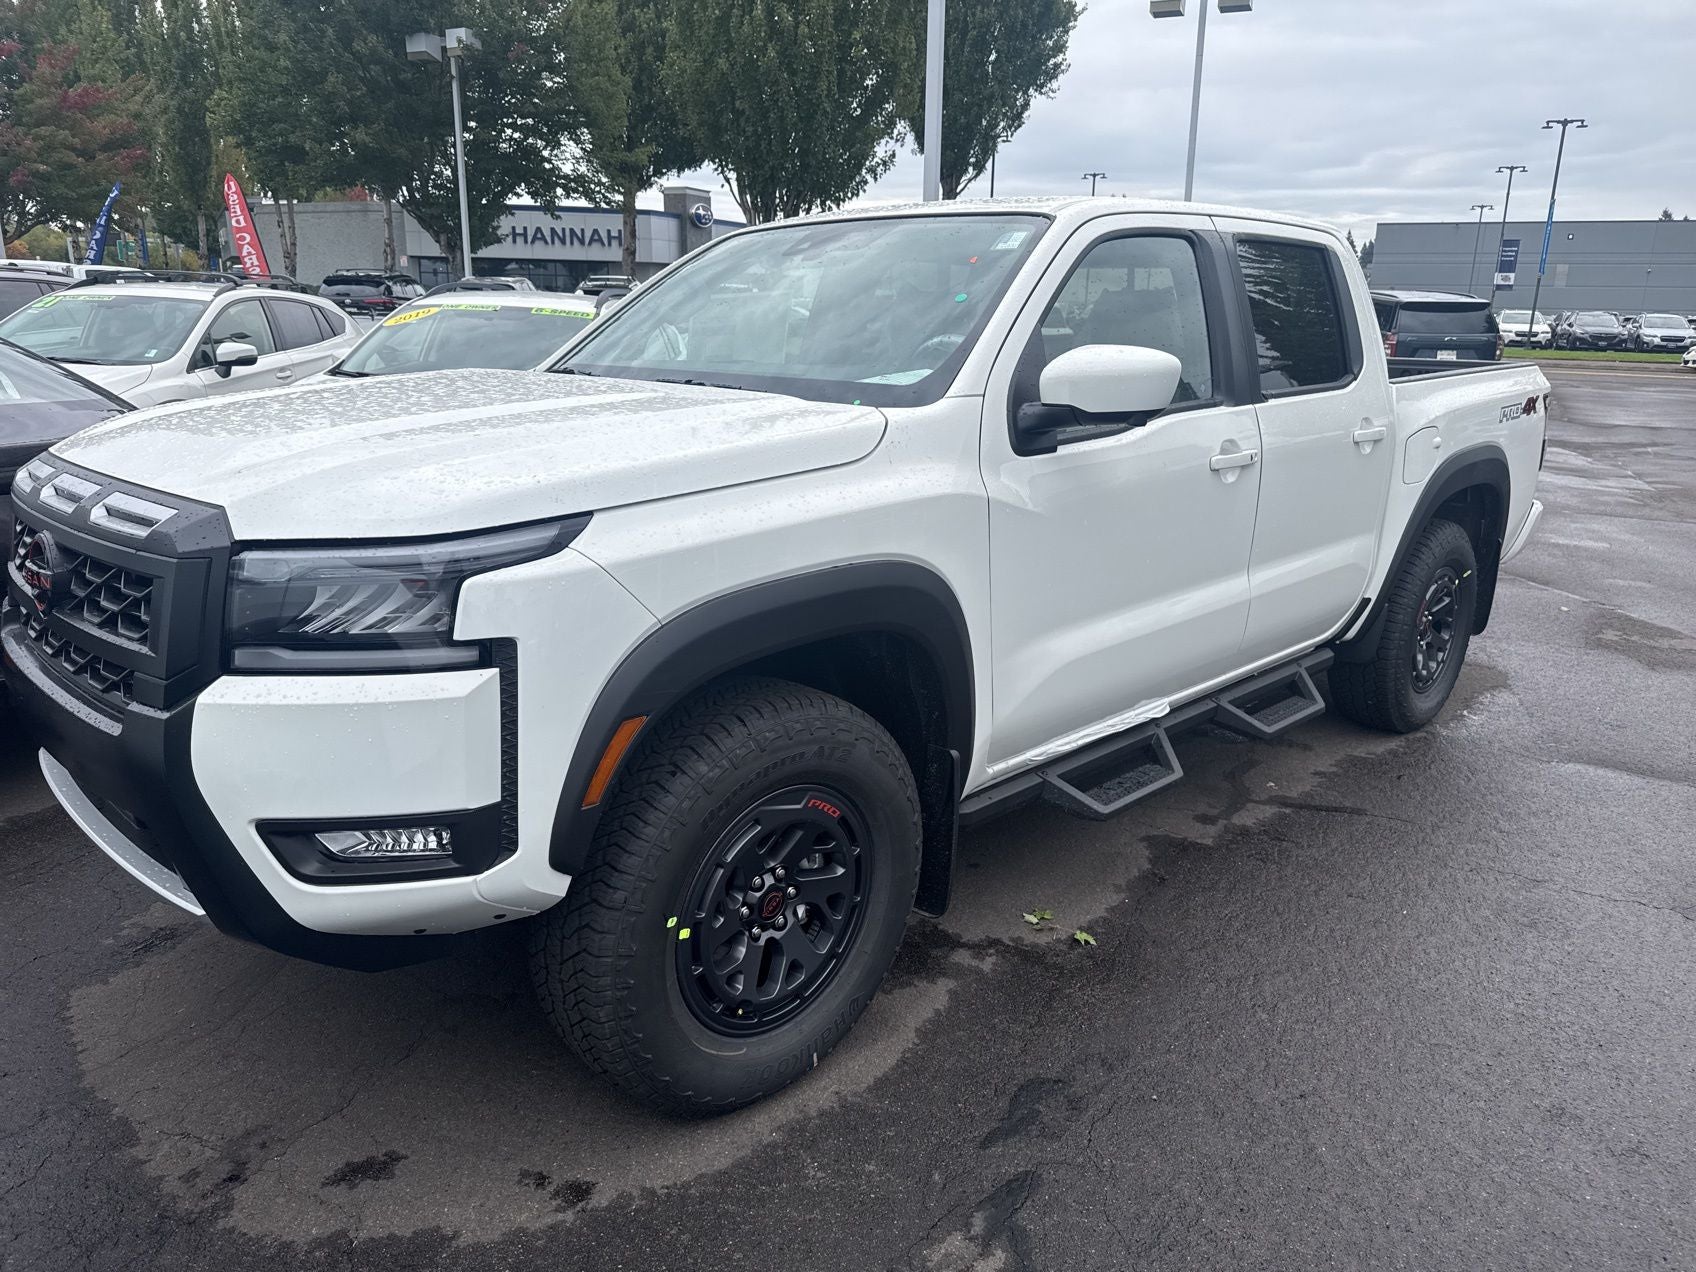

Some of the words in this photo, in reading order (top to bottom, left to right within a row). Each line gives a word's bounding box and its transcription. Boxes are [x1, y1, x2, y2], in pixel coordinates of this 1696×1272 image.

[511, 225, 623, 247] HANNAH
[395, 308, 432, 324] 2019
[807, 799, 840, 818] PRO
